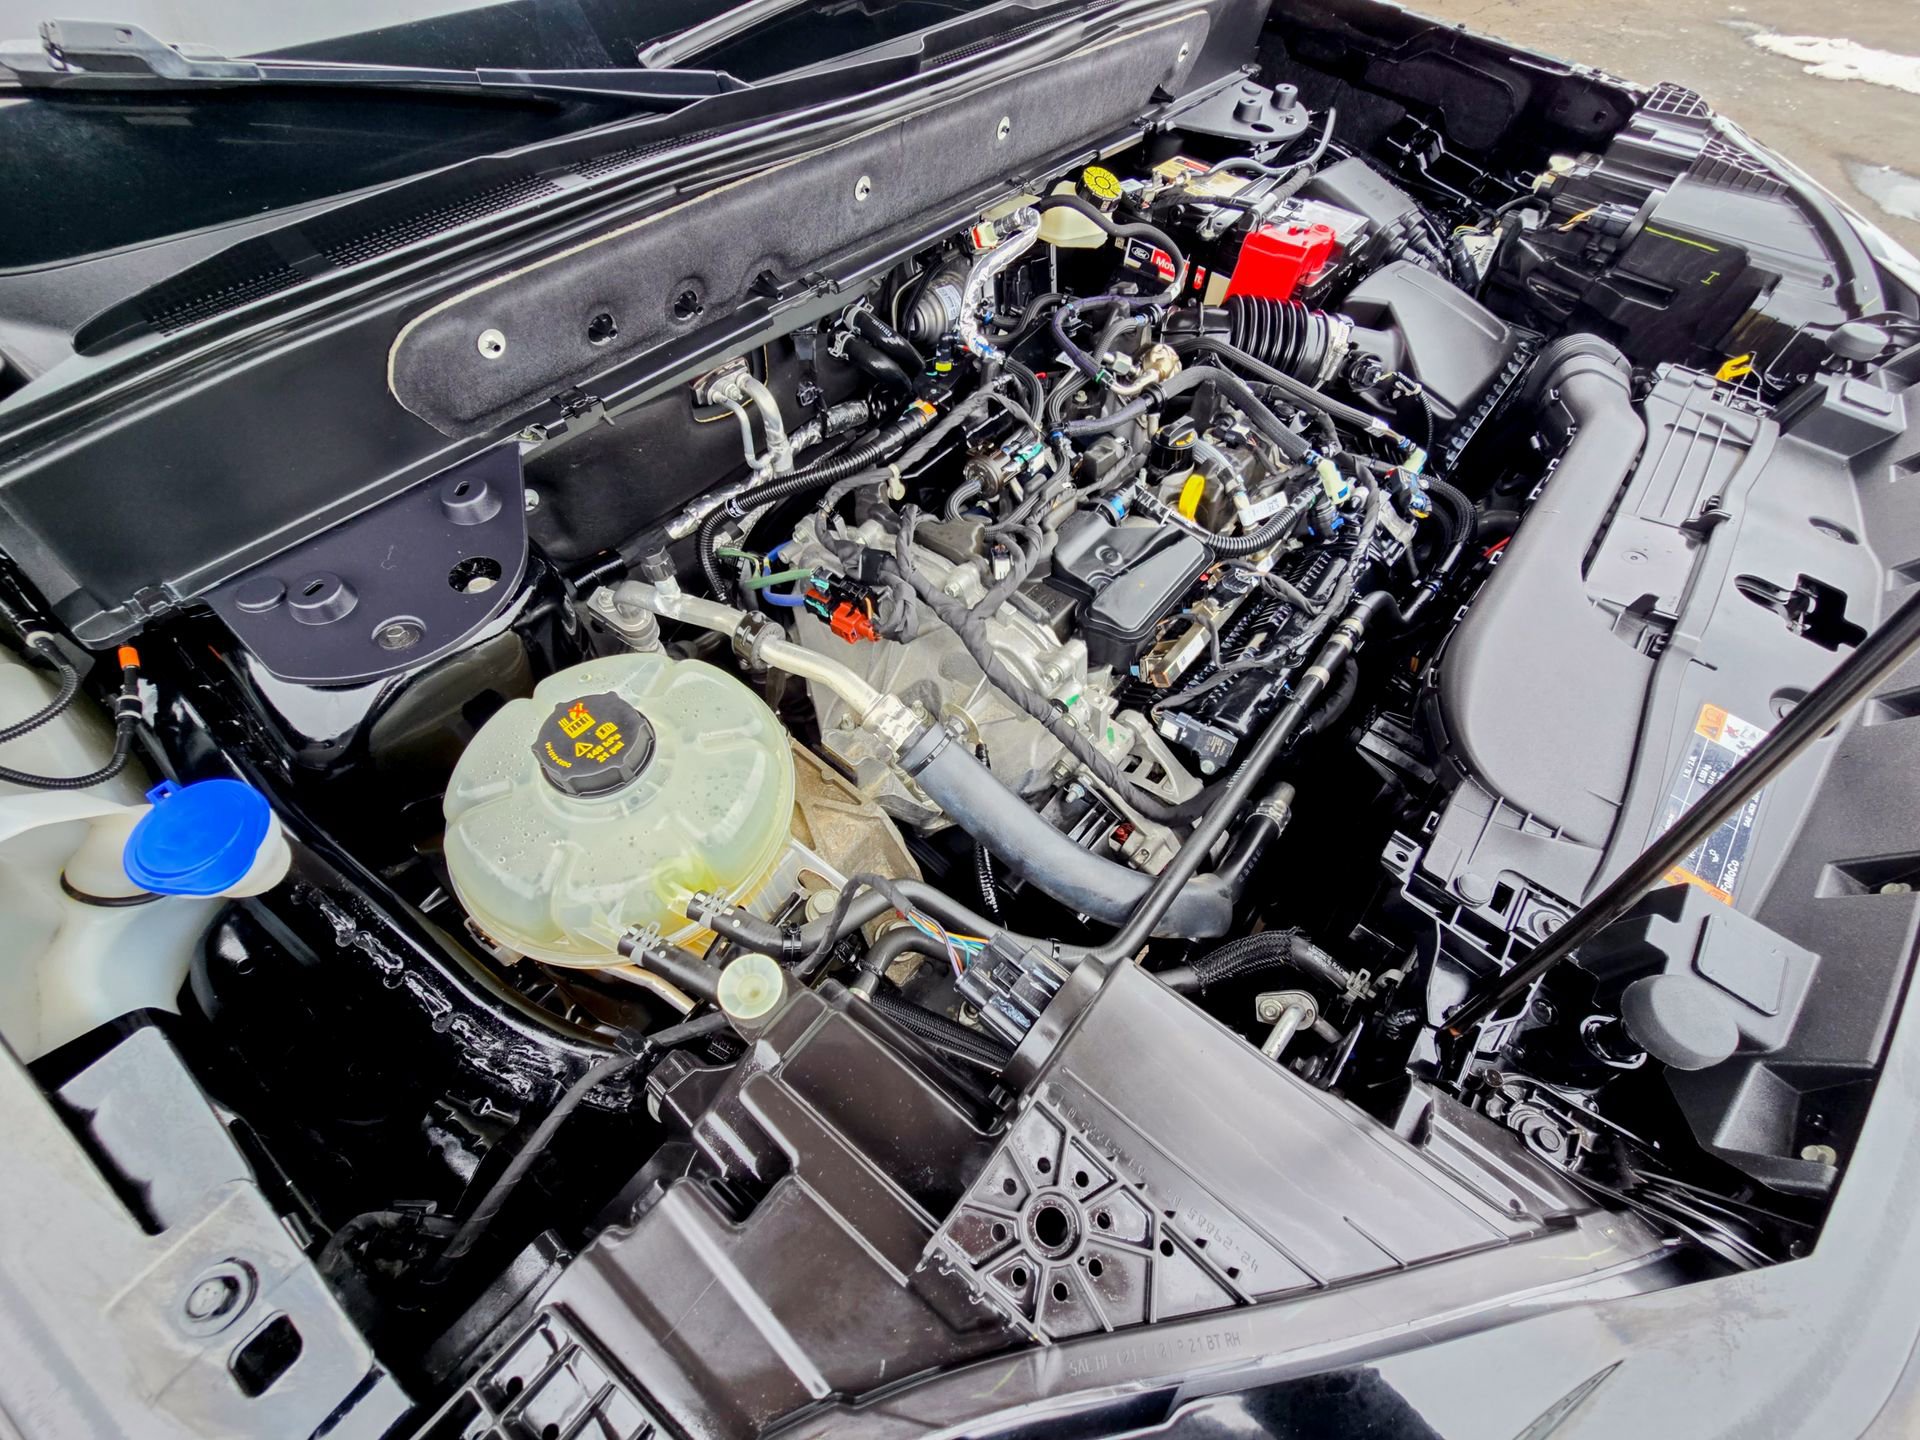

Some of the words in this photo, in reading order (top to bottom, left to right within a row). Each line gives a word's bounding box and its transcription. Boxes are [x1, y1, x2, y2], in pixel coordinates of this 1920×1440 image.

[1720, 859, 1740, 893] FoMoCo
[1206, 1334, 1220, 1350] BT
[1225, 1331, 1241, 1347] RH
